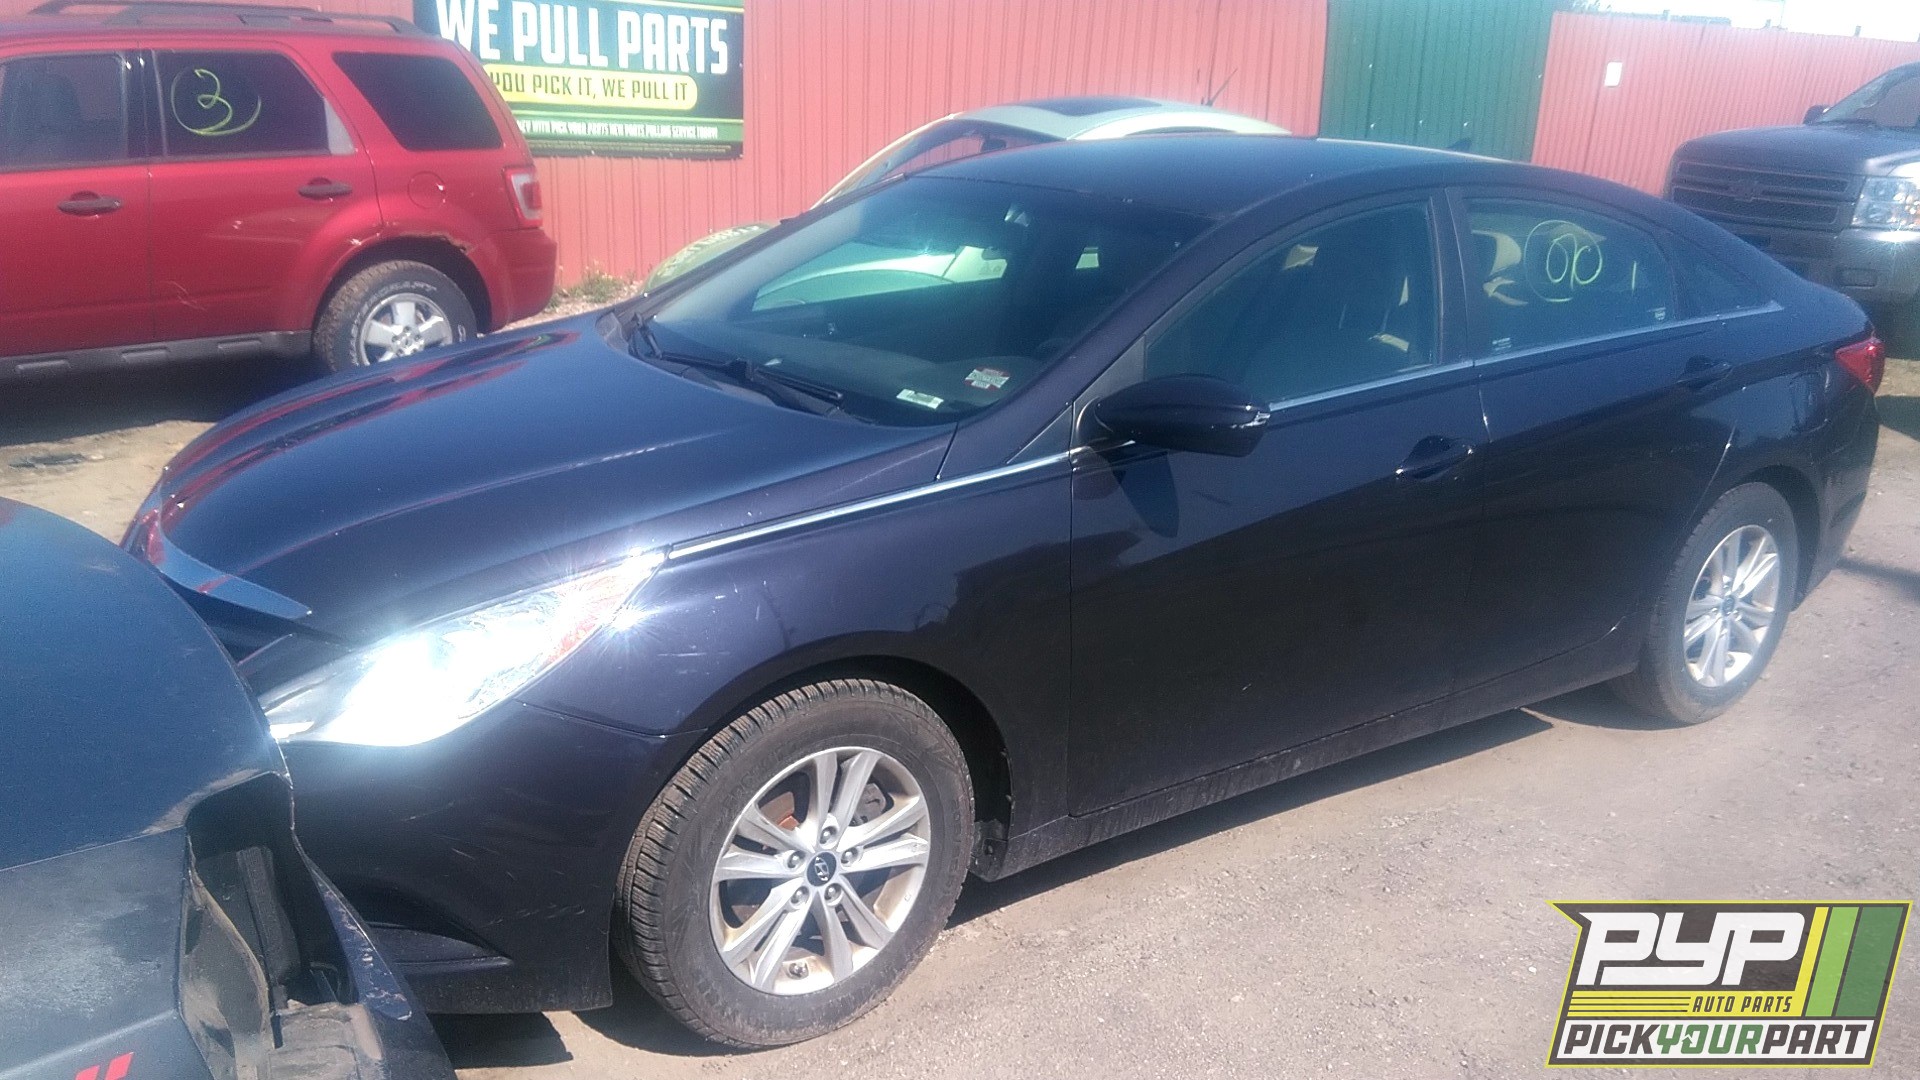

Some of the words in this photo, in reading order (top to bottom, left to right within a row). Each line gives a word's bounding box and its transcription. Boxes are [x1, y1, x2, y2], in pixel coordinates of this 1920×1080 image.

[436, 0, 500, 60] WE
[512, 0, 608, 68] PULL
[617, 9, 728, 74] PARTS
[489, 71, 525, 93] YOU
[532, 74, 572, 95] PICK
[578, 76, 597, 99] IT,
[602, 78, 625, 98] WE
[632, 80, 669, 100] PULL
[675, 82, 688, 101] IT
